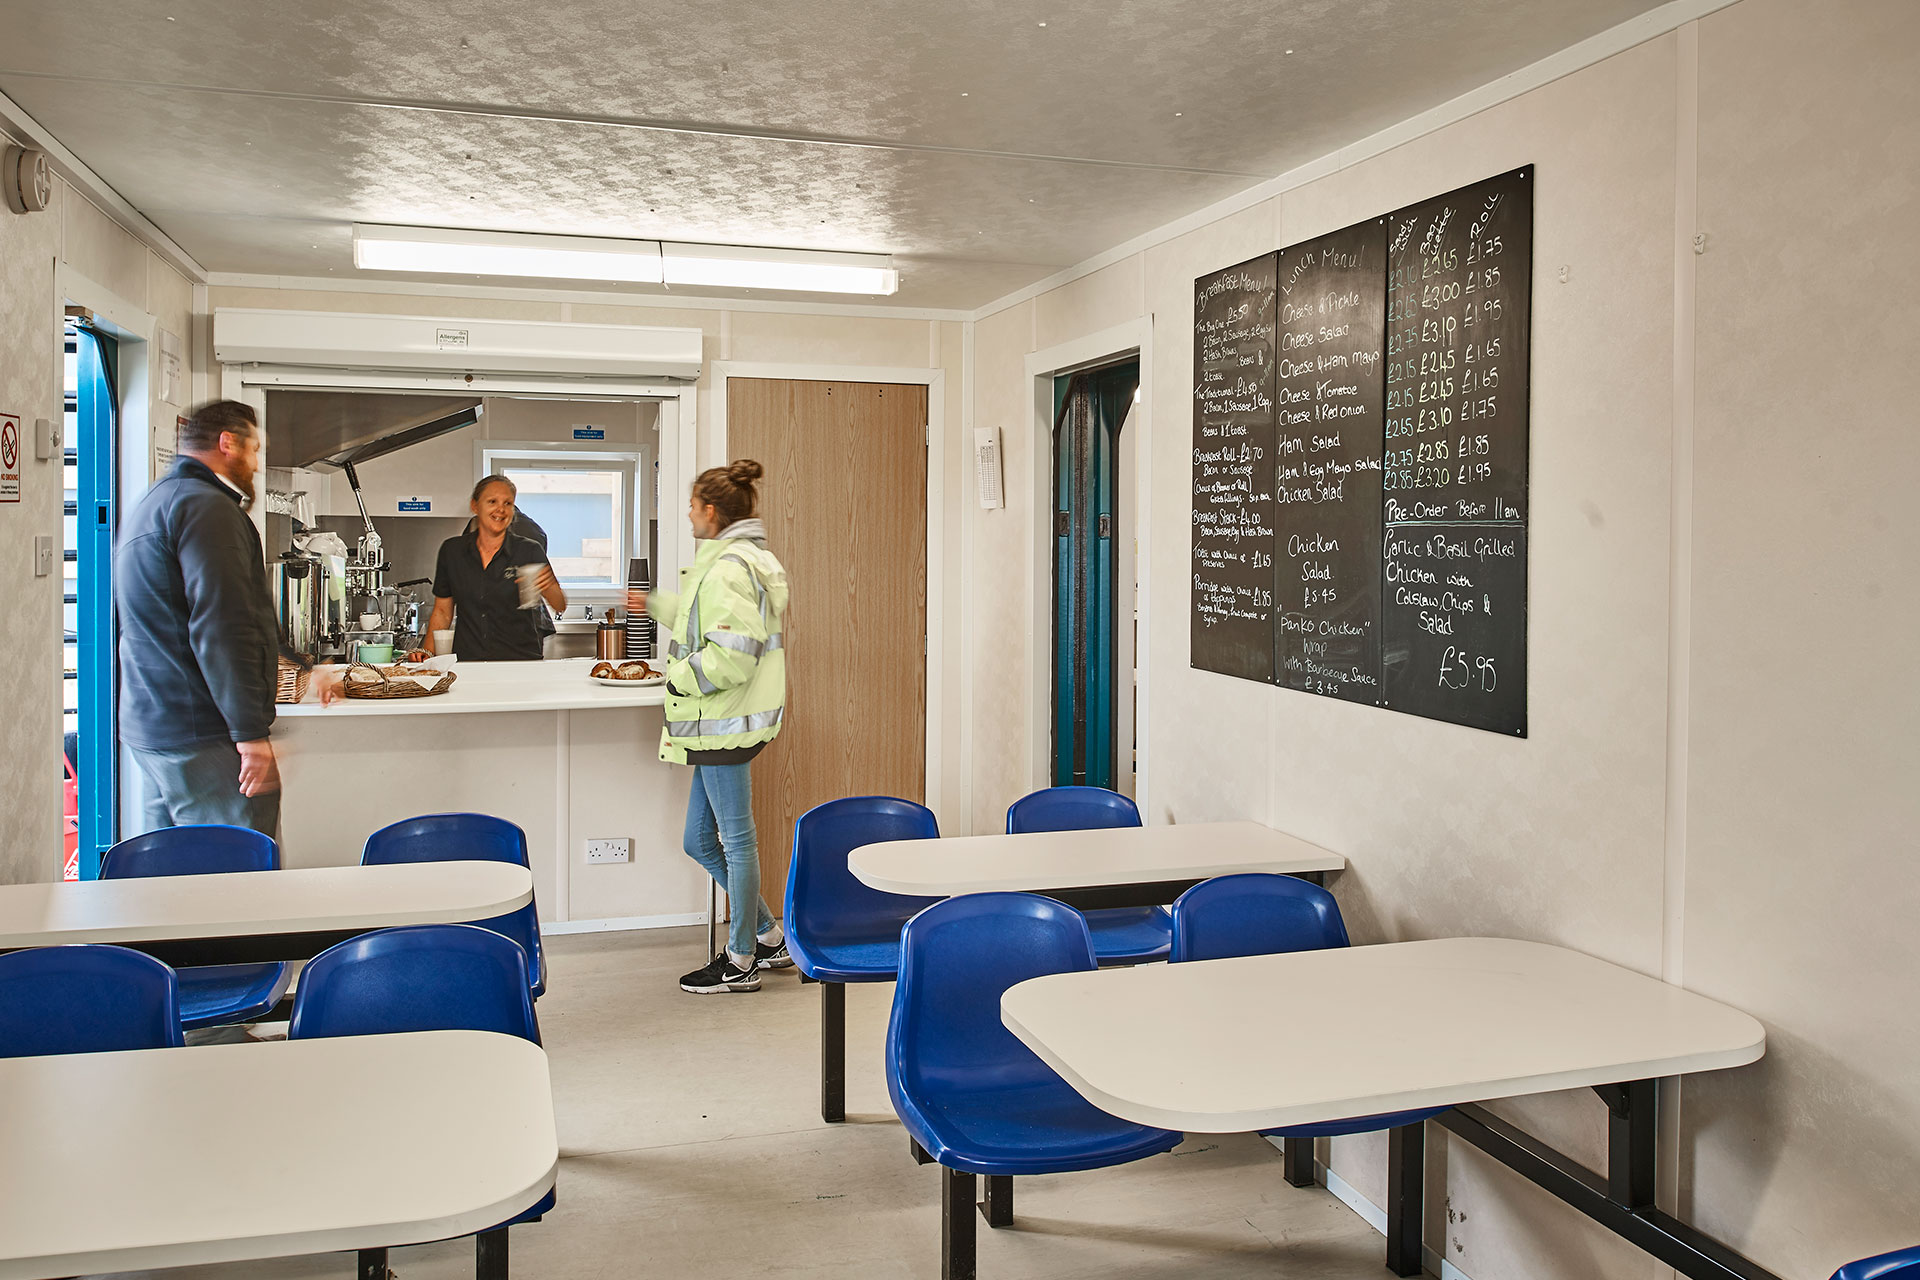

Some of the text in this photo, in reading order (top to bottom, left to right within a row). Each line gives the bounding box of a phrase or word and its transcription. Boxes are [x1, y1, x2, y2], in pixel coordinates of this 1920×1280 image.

[1467, 236, 1503, 265] £1.75
[1282, 253, 1315, 295] Lunch
[1422, 248, 1458, 280] £2.65
[1196, 273, 1238, 312] Breakfast
[1465, 266, 1501, 294] £1.85
[1282, 303, 1313, 324] Cheese
[1326, 291, 1360, 312] Pickle
[1421, 282, 1460, 310] £3.00
[1464, 299, 1502, 327] £1.95
[1195, 319, 1206, 334] The
[1282, 324, 1349, 351] Cheese Salad
[1422, 316, 1457, 345] £3.10
[1465, 338, 1501, 363] £1.65
[1280, 359, 1314, 378] Cheese
[1324, 354, 1348, 371] Ham
[1388, 359, 1417, 383] £2.15
[1194, 383, 1205, 400] The
[1419, 377, 1454, 402] £2.45
[1462, 367, 1499, 395] £1.65
[1280, 387, 1311, 405] Cheese
[1387, 388, 1414, 410] £2.15
[1461, 396, 1496, 421] £1.75
[1279, 410, 1311, 425] Cheese
[1322, 403, 1338, 420] Red
[1417, 406, 1452, 433] £3.10
[1385, 418, 1414, 438] £2.65
[1278, 430, 1341, 457] Ham Salad
[1459, 434, 1489, 458] £1.85
[1384, 448, 1414, 470] £2.75
[1278, 464, 1300, 486] Ham
[1309, 464, 1324, 483] Egg
[1326, 459, 1352, 482] Mayo
[1383, 470, 1414, 491] £2.85
[1414, 466, 1450, 488] £3.20
[1458, 462, 1491, 484] £1.95
[1277, 481, 1343, 504] Chicken Salad
[1456, 499, 1487, 519] Before
[1288, 532, 1339, 557] Chicken
[1383, 529, 1422, 561] Garlic
[1434, 534, 1471, 560] Basil
[1474, 537, 1516, 563] Grilled
[1386, 561, 1474, 587] Chicken with
[1304, 587, 1337, 609] £5.45
[1441, 592, 1474, 615] Chips
[1417, 611, 1454, 635] Salad
[1350, 666, 1377, 686] Sauce
[1438, 645, 1497, 692] £5.95
